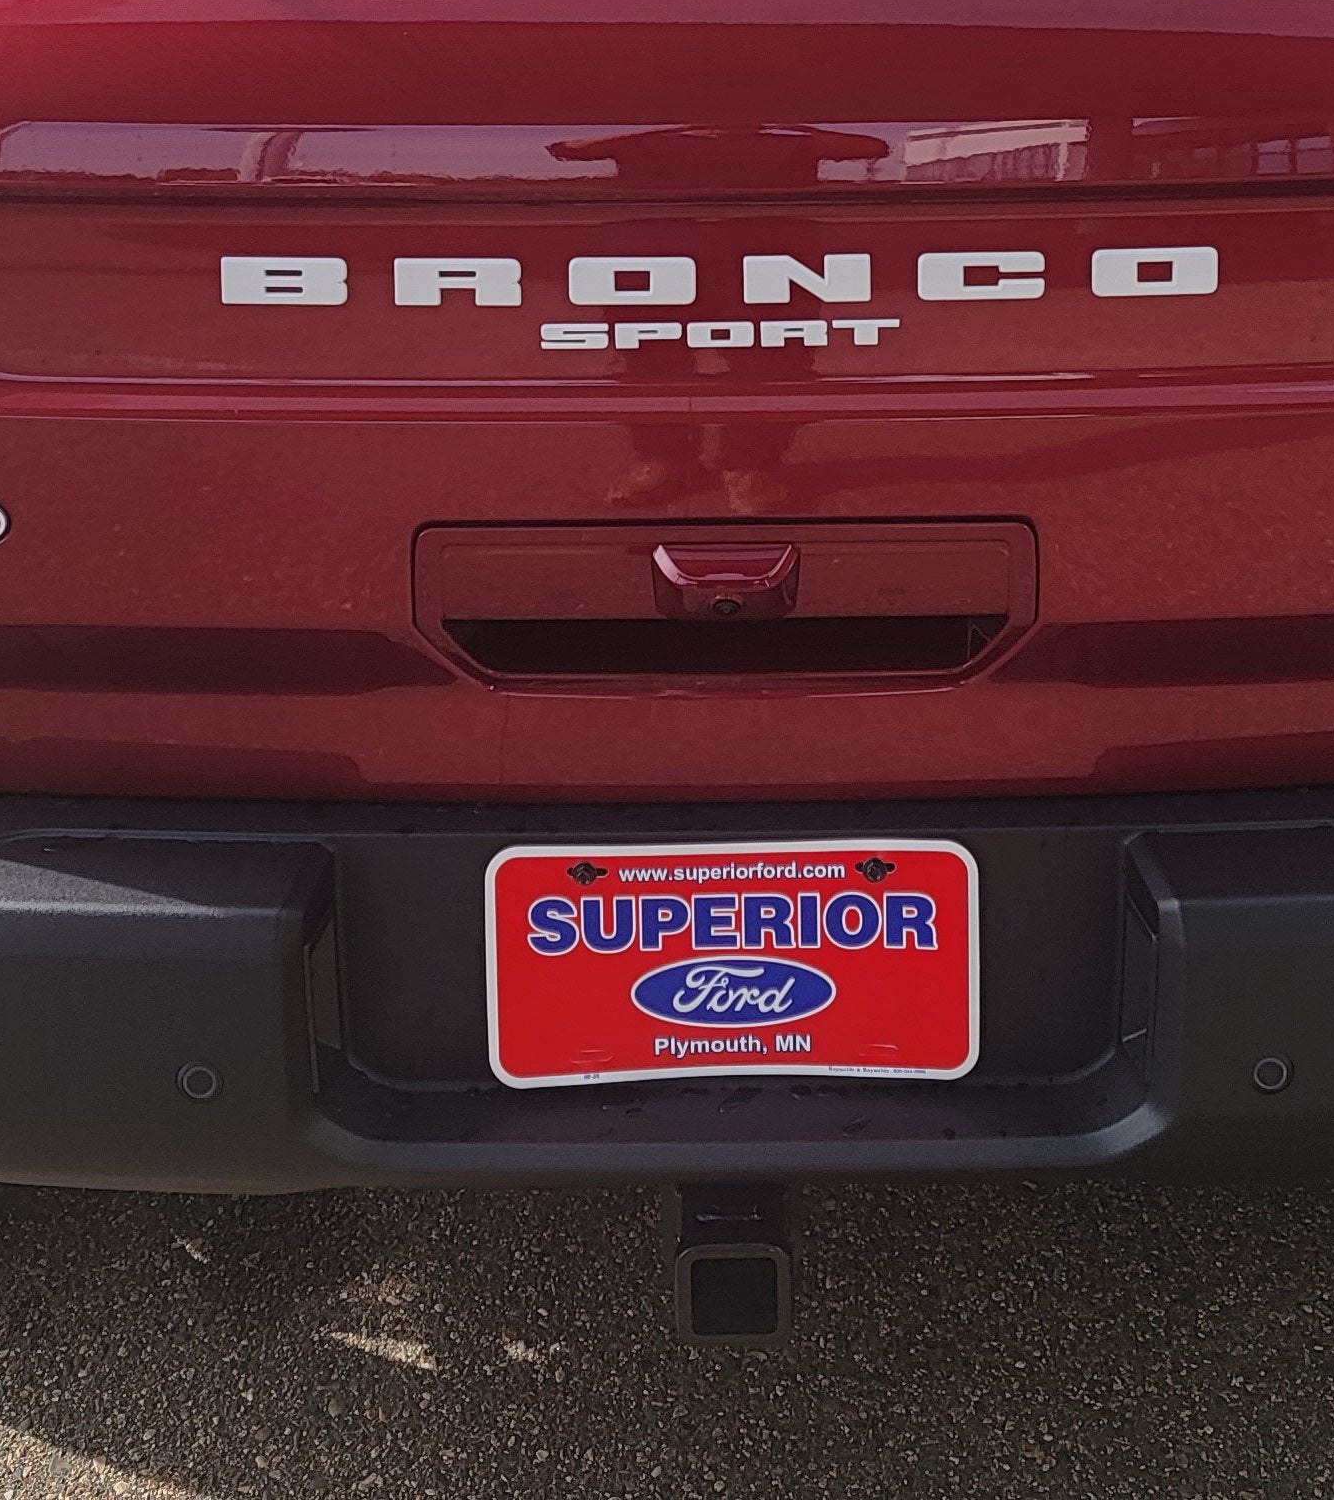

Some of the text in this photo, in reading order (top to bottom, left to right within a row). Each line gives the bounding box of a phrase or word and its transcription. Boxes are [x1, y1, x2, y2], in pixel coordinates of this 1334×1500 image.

[220, 245, 1219, 308] BRONCO
[539, 318, 901, 351] SPORT
[618, 861, 846, 884] www.superiorford.com
[527, 892, 938, 955] SUPERIOR
[673, 965, 793, 1014] Ford
[654, 1034, 811, 1058] Plymouth, MN
